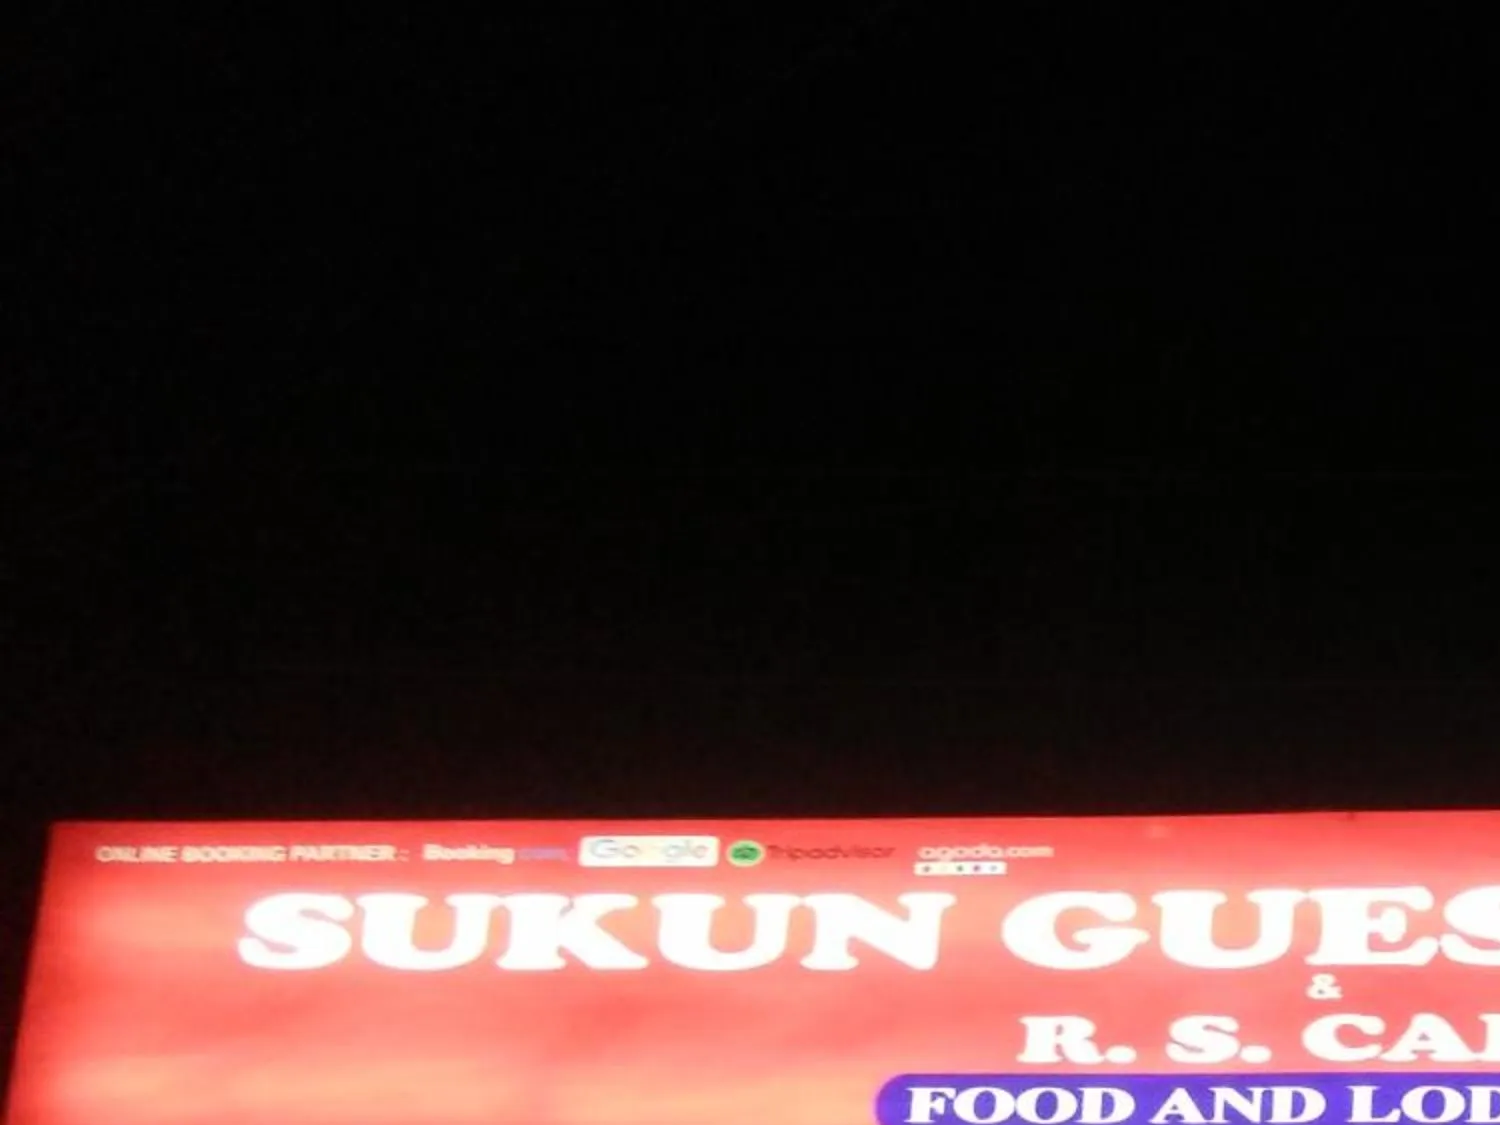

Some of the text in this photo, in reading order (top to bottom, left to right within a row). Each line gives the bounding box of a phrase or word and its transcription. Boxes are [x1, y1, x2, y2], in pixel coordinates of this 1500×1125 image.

[588, 839, 708, 862] Gogle
[236, 889, 957, 971] SUKUN
[1306, 973, 1341, 999] &
[1016, 1014, 1137, 1064] R.
[1164, 1013, 1272, 1064] S.
[905, 1085, 1136, 1125] FOOD
[1149, 1085, 1327, 1125] AND
